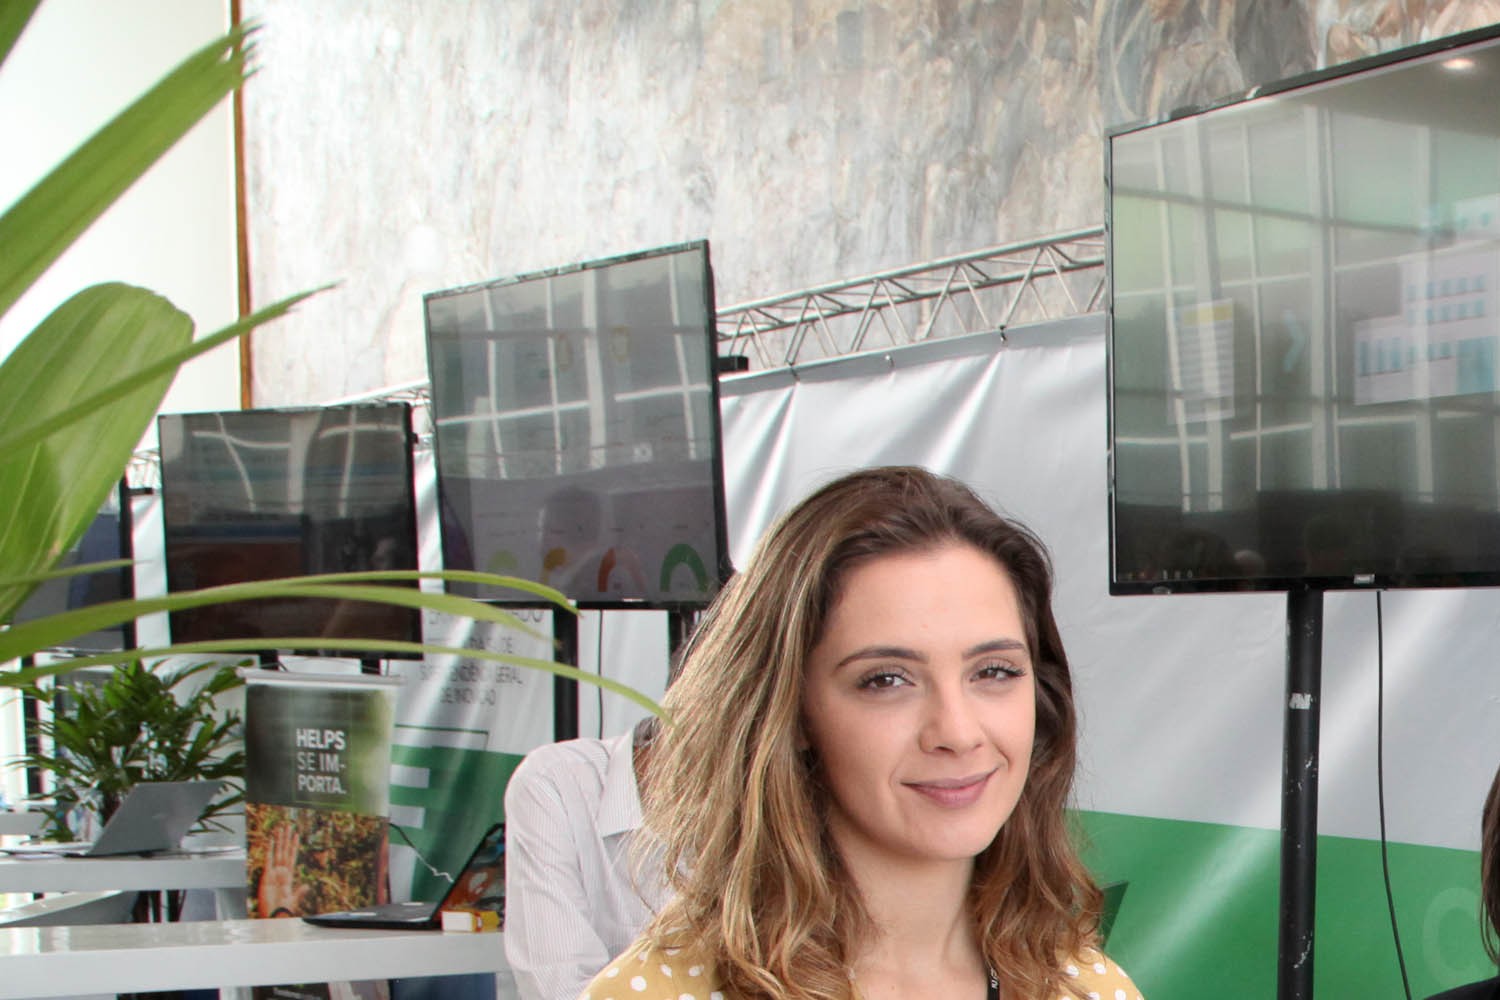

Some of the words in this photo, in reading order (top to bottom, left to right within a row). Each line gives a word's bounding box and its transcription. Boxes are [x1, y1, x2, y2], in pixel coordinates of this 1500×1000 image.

[296, 728, 346, 750] HELPS
[297, 752, 315, 771] SE
[319, 754, 346, 774] IM-
[297, 775, 347, 795] PORTA.
